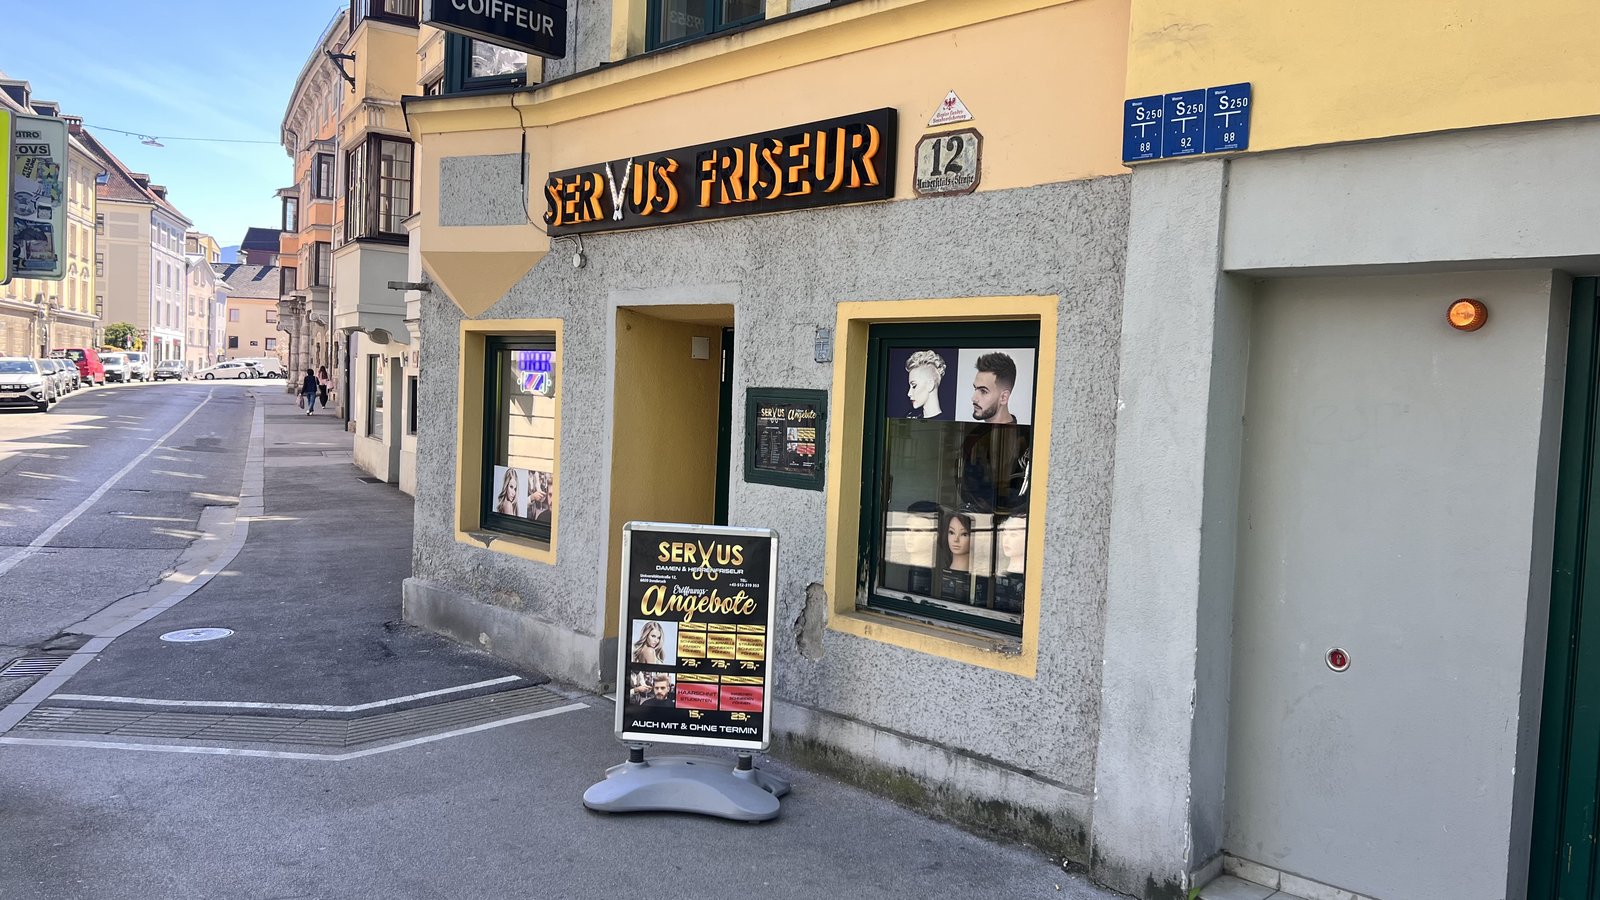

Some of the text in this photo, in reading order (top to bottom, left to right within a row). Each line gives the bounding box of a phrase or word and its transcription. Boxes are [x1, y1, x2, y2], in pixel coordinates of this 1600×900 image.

[451, 0, 554, 37] COIFFEUR
[15, 145, 47, 154] OVS
[930, 135, 965, 177] 12
[543, 123, 880, 227] SERVUS FRISEUR
[658, 540, 744, 567] SERVUS
[687, 566, 744, 575] HERRENFRISEUR
[631, 719, 758, 735] AUCH MIT & OHNE TERMIN
